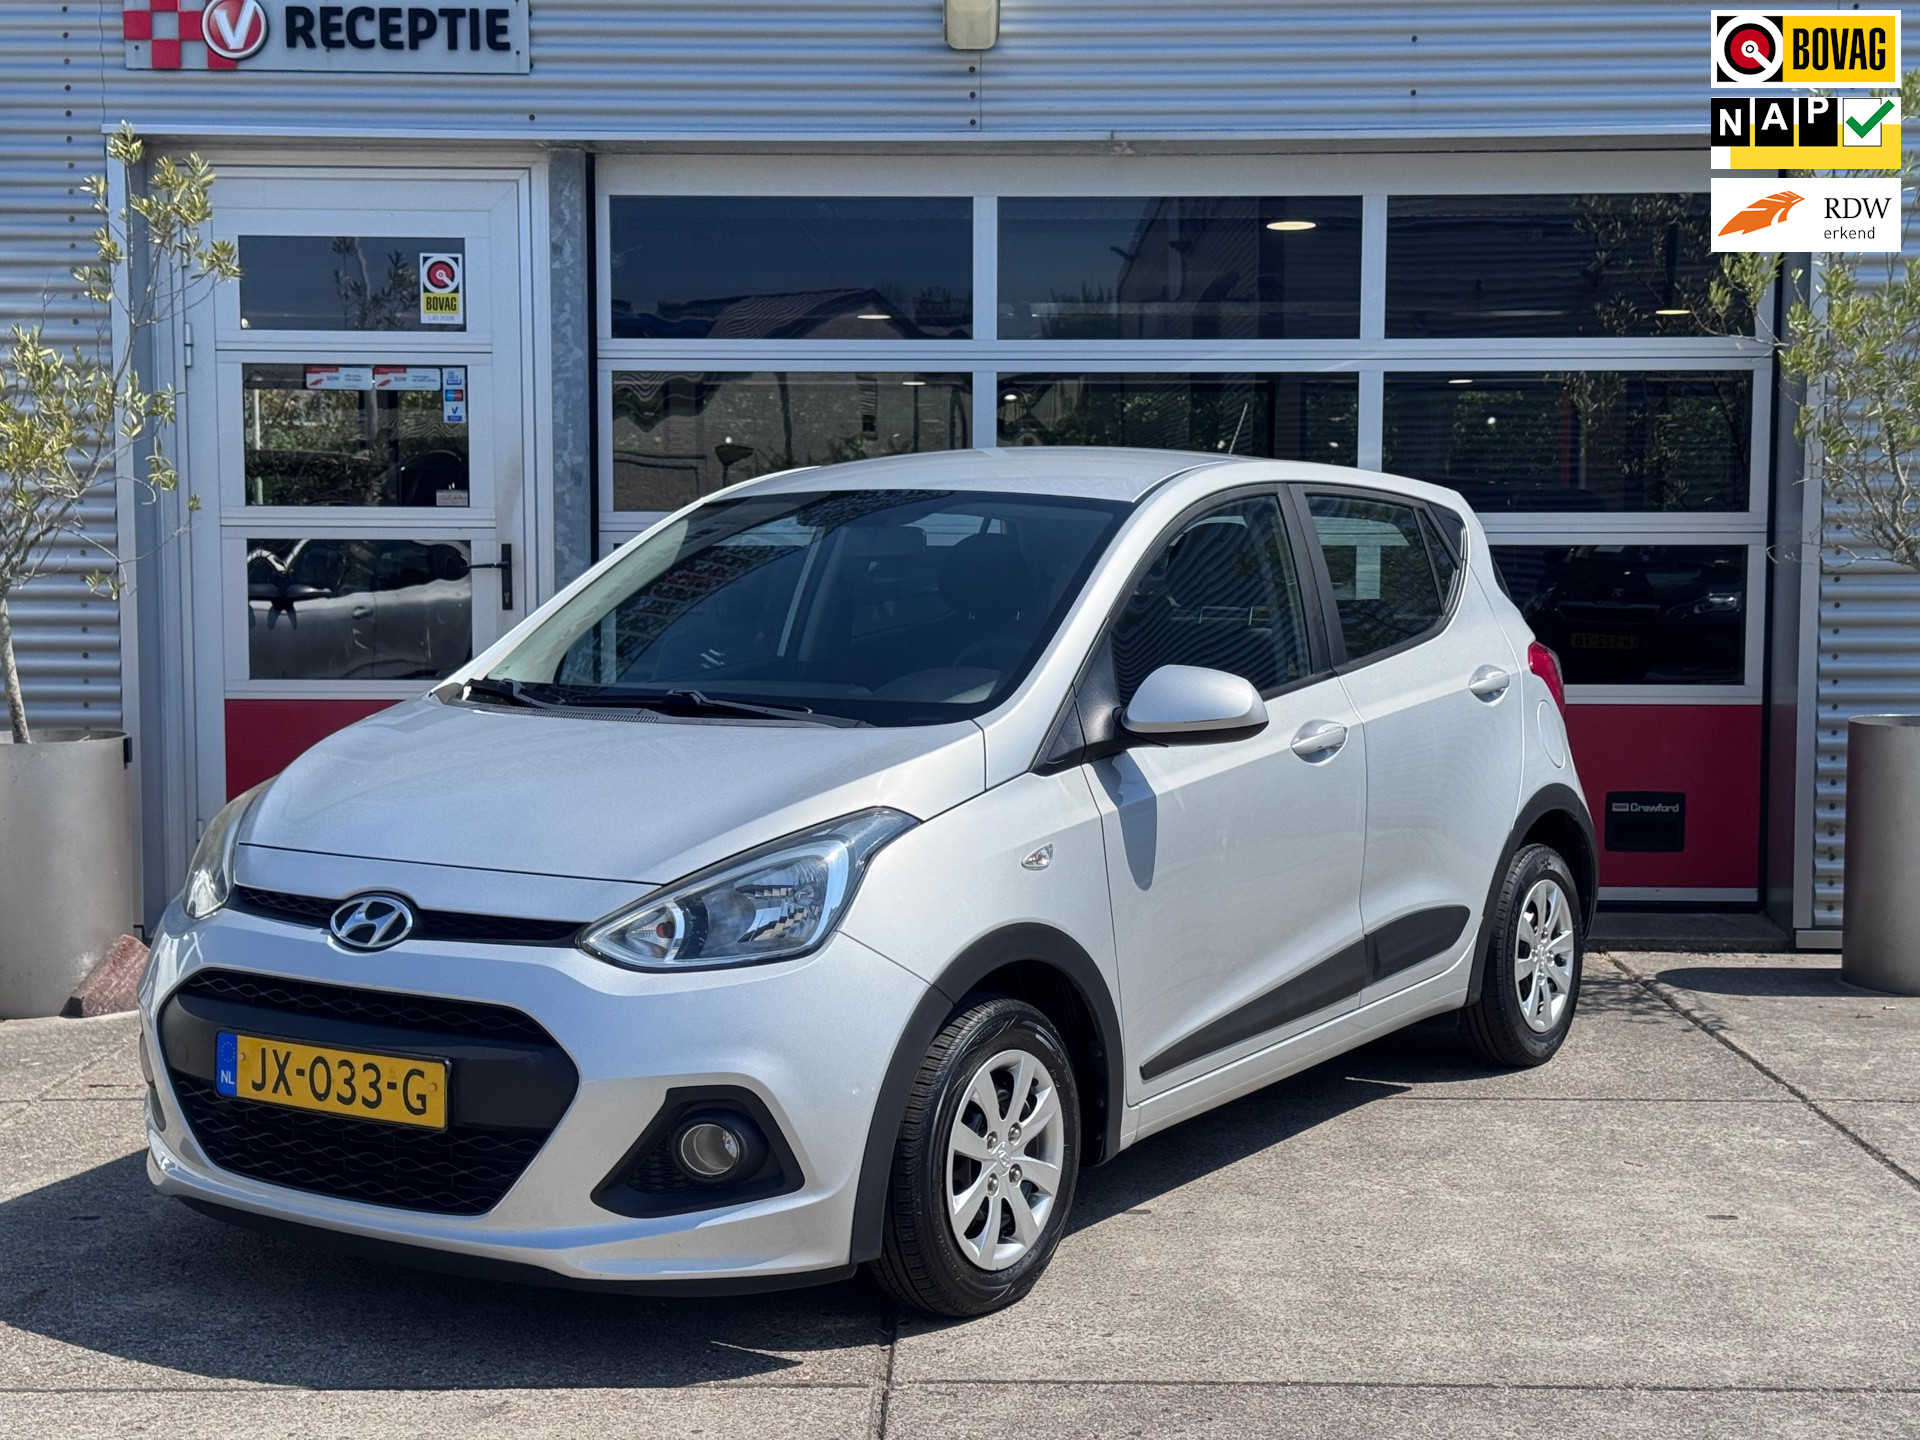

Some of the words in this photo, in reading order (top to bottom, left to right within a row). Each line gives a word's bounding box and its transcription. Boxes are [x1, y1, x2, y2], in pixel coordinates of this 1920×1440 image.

[285, 6, 512, 51] RECEPTIE
[426, 296, 457, 311] BOVAG
[1630, 803, 1680, 812] Crawford
[220, 1069, 235, 1085] NL
[251, 1047, 427, 1116] JX-033-G
